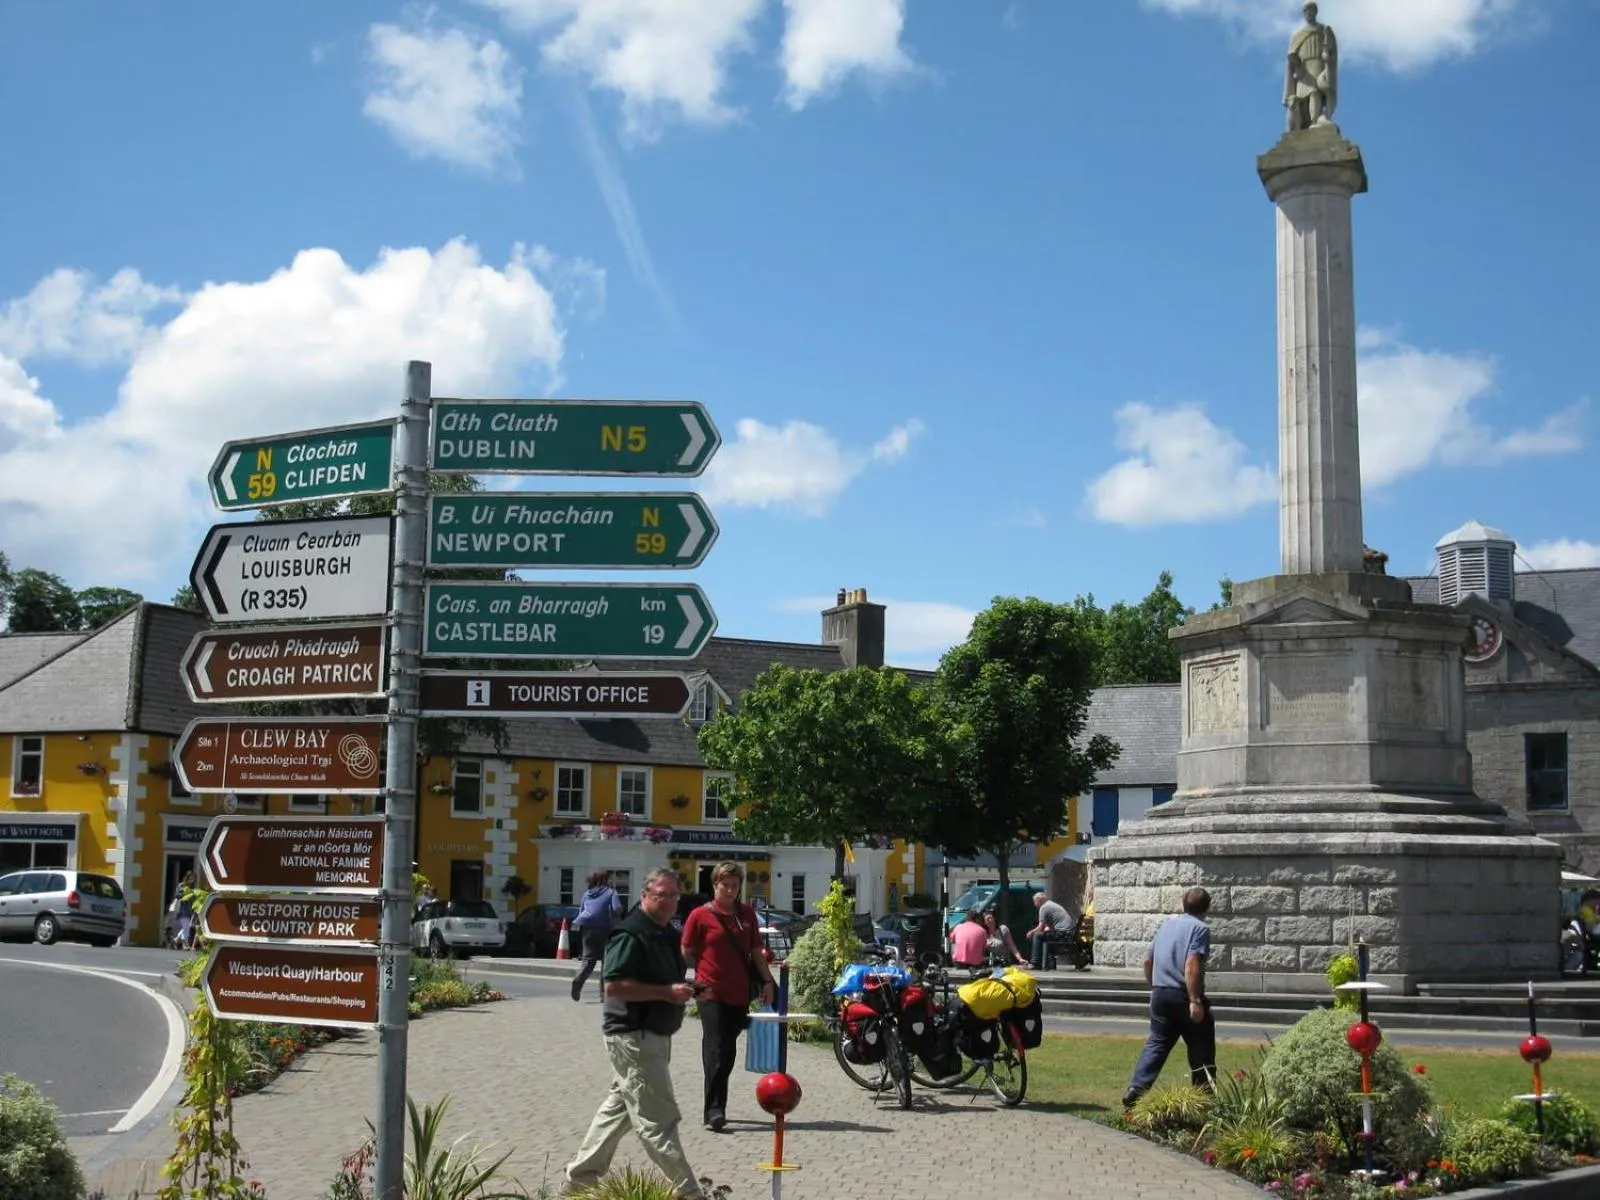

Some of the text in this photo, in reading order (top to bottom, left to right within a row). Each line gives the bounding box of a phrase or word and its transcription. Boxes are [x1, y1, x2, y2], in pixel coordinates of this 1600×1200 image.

[490, 413, 559, 432] Cliath
[287, 439, 358, 464] Clochán
[439, 440, 536, 458] DUBLIN
[257, 448, 272, 471] N
[248, 472, 276, 499] 59
[285, 462, 366, 489] CLIFDEN
[438, 505, 614, 525] B. Uí Fhiacháin
[642, 507, 659, 527] N
[243, 530, 361, 553] Cluain Cearbán
[436, 533, 565, 552] NEWPORT
[635, 533, 666, 554] 59
[241, 556, 351, 580] LOUISBURGH
[489, 599, 510, 614] an
[518, 595, 609, 618] Bharraigh
[640, 597, 666, 612] km
[435, 622, 557, 642] CASTLEBAR
[643, 625, 665, 644] 19
[228, 636, 360, 660] Cruach Phádraigh
[226, 663, 373, 687] CROAGH PATRICK
[508, 685, 582, 702] TOURIST
[586, 686, 648, 703] OFFICE
[241, 728, 331, 748] CLEW BAY
[196, 761, 214, 772] 2km
[230, 754, 308, 767] Archaeological
[257, 827, 373, 839] Cuimhneachán Náisiúnta
[292, 842, 372, 854] ar an nGorta Mór
[280, 856, 370, 869] NATIONAL FAMINE
[316, 871, 369, 883] MEMORIAL
[238, 903, 360, 920] WESTPORT HOUSE
[239, 920, 355, 937] & COUNTRY PARK
[229, 960, 364, 983] Westport Quay/Harbour
